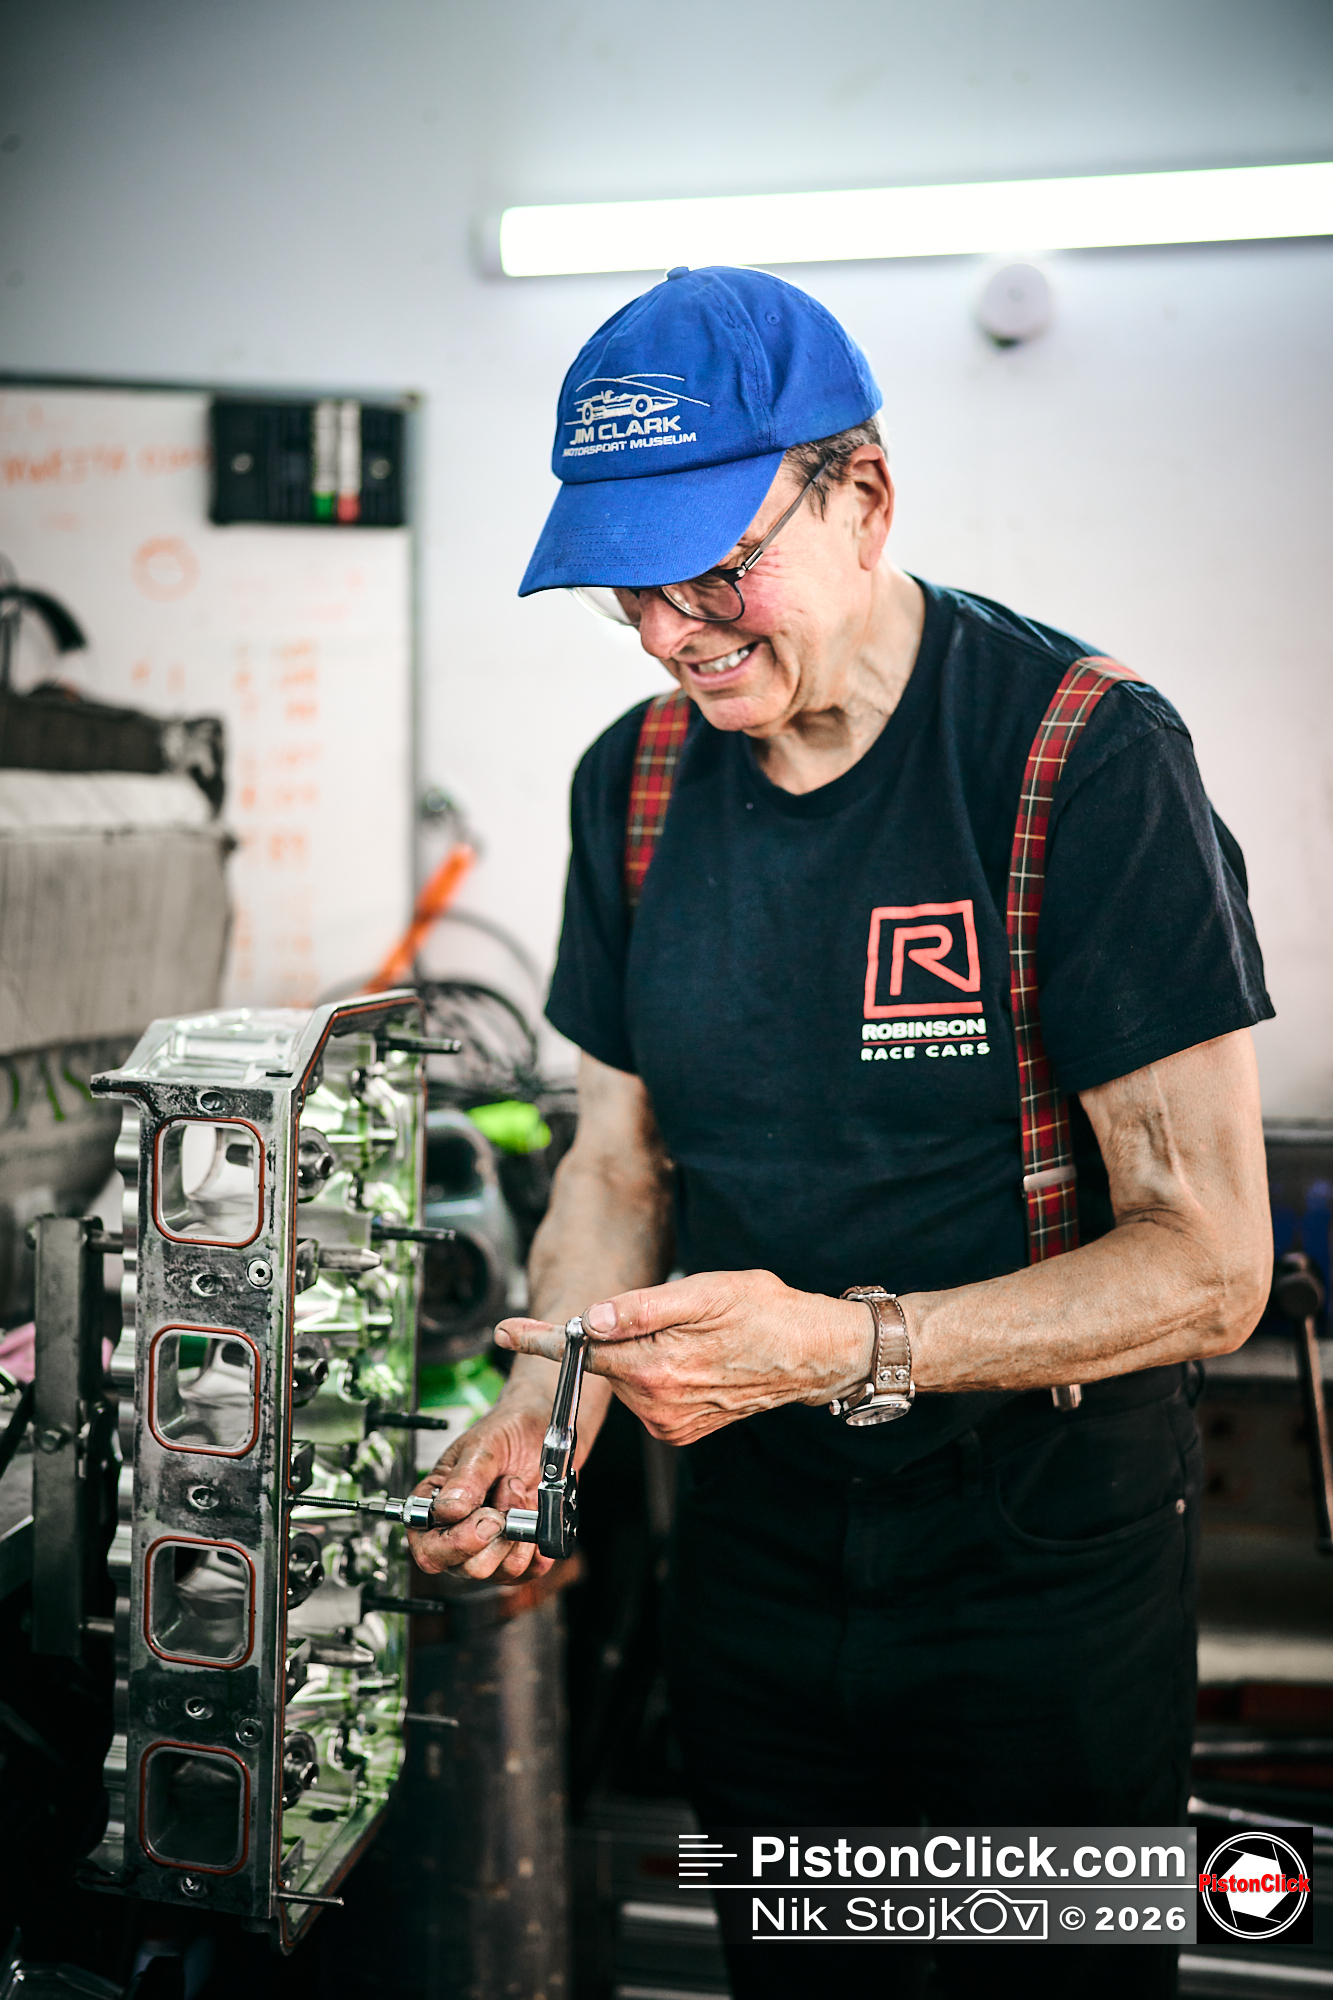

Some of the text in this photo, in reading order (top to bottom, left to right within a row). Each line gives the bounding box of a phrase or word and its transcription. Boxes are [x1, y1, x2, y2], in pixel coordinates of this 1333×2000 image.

[569, 415, 682, 445] JIM CLARK
[562, 432, 697, 457] MOTORSPORT MUSEUM
[861, 1018, 987, 1041] ROBINSON
[860, 1042, 991, 1061] RACE CARS
